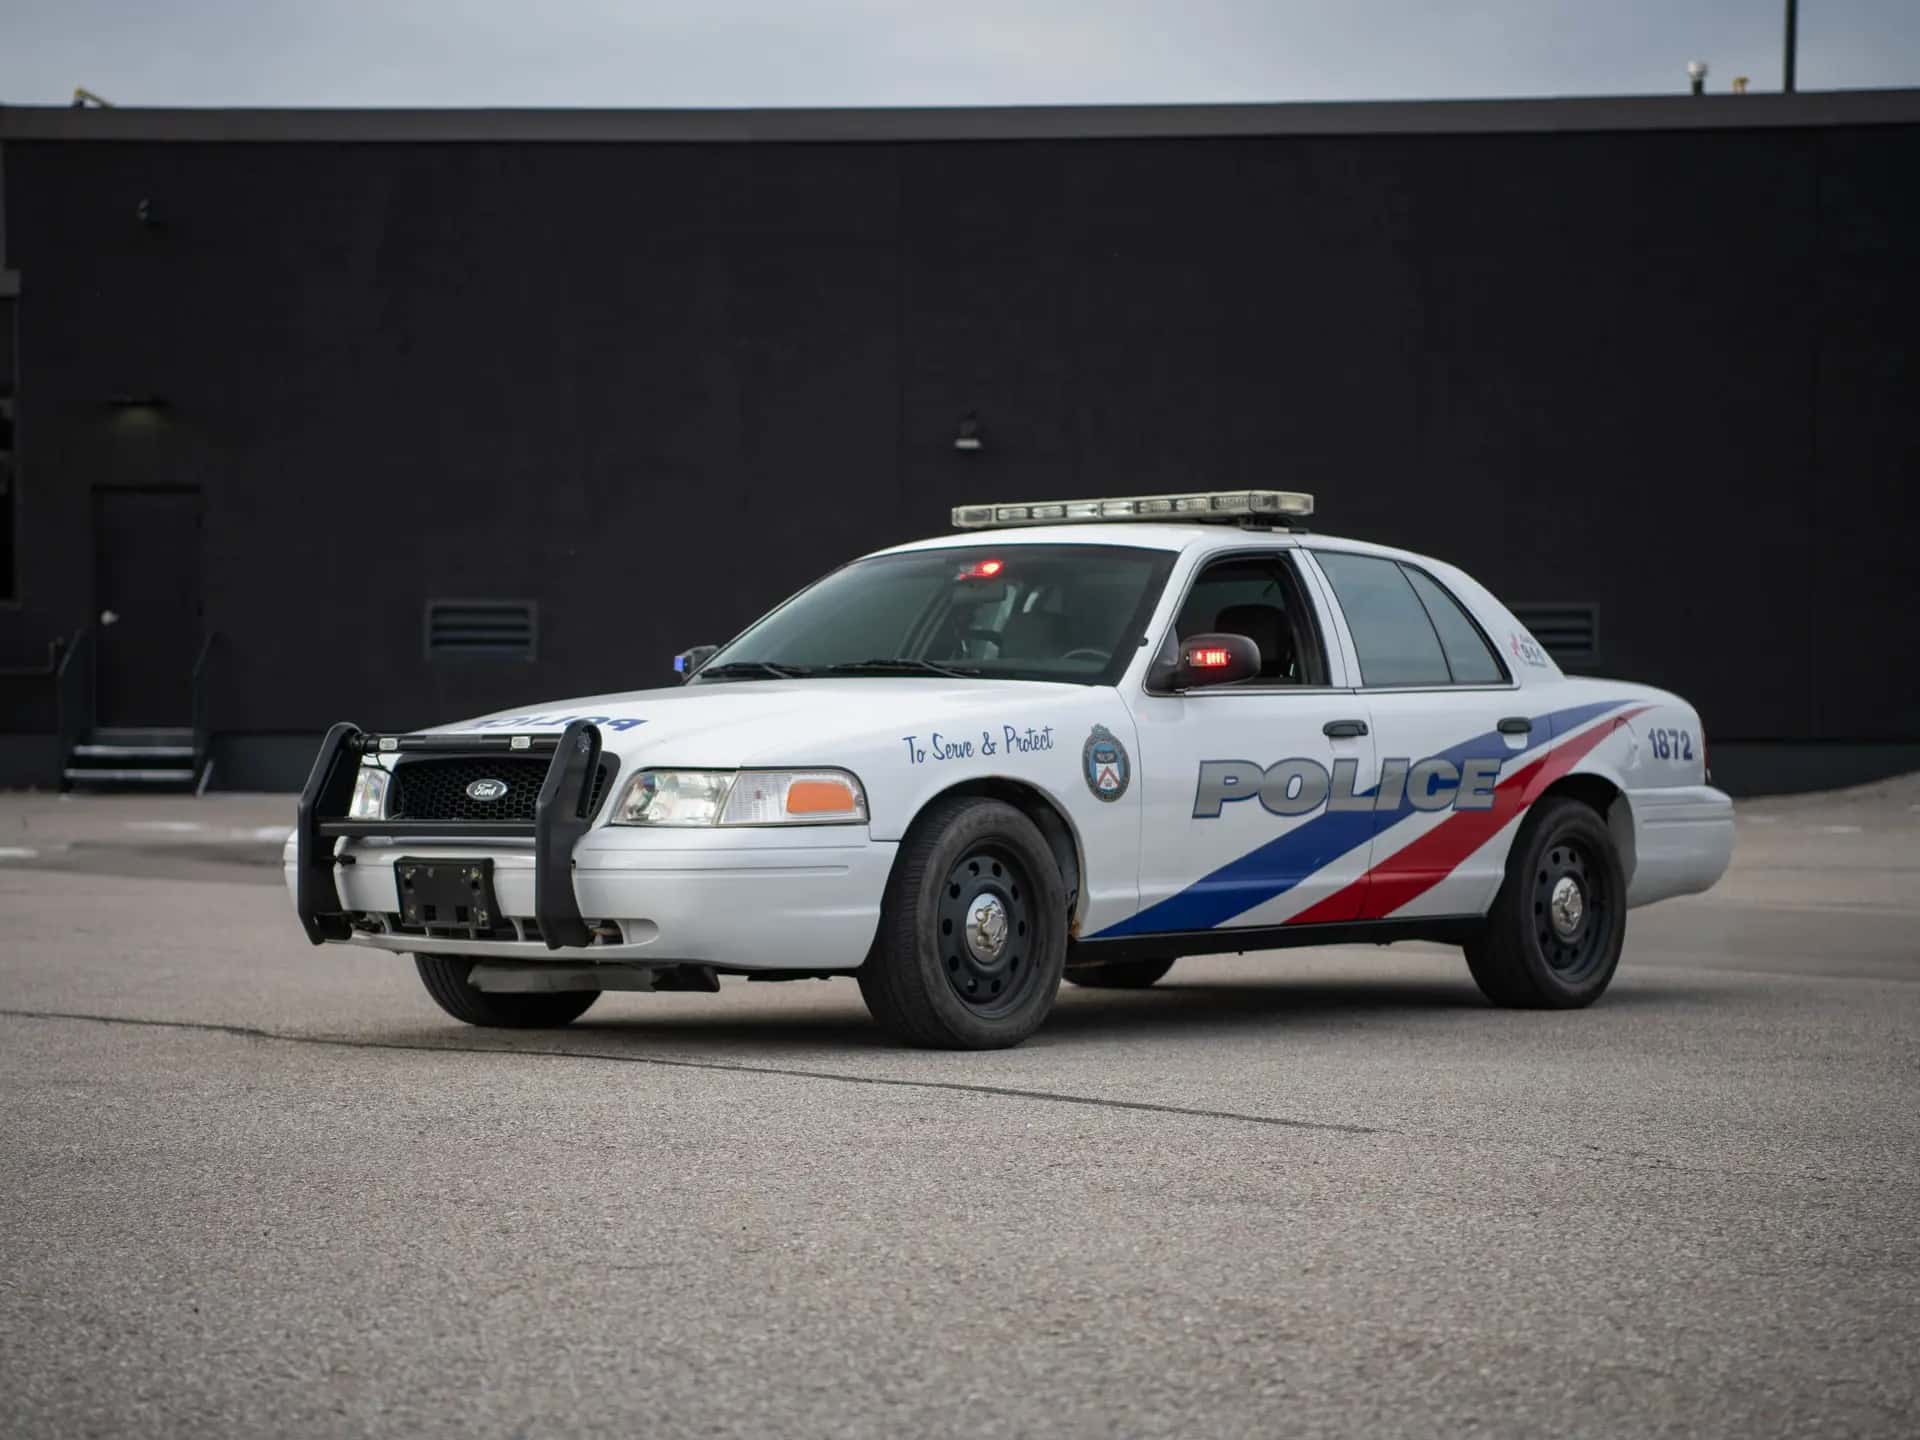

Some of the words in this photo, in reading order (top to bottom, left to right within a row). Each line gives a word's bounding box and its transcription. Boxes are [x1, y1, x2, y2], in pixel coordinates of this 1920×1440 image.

[902, 735, 925, 764] To
[932, 732, 974, 760] Serve
[982, 731, 997, 755] &
[1003, 724, 1053, 754] Protect
[1647, 727, 1693, 760] 1872
[1192, 757, 1502, 819] POLICE
